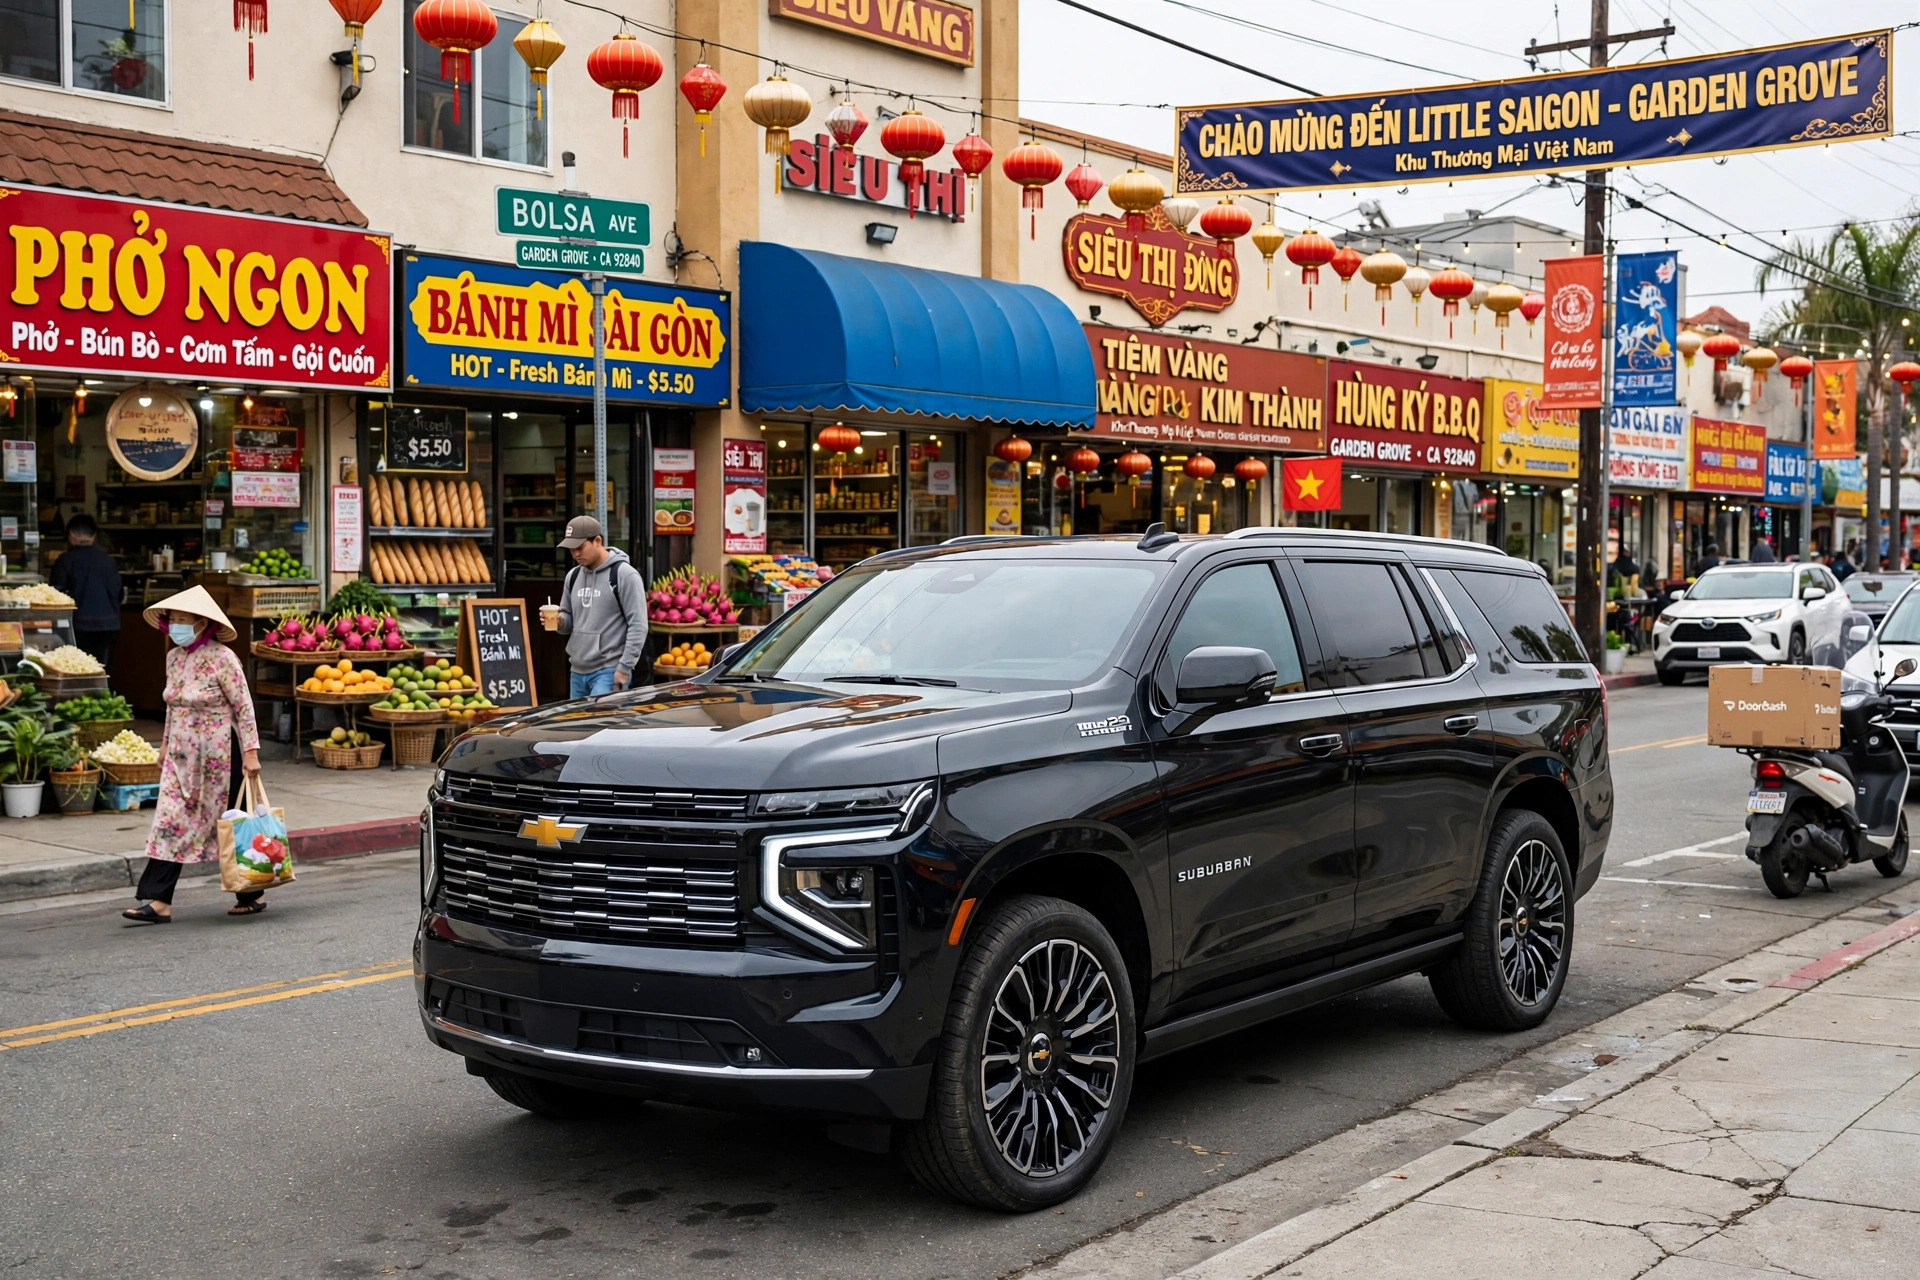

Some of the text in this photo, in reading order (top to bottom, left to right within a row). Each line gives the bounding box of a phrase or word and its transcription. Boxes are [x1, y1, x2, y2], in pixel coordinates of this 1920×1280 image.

[1200, 114, 1264, 158] CHÀO
[1270, 109, 1343, 154] MỪNG
[1350, 98, 1401, 148] ĐẾN
[1408, 100, 1491, 143] LITTLE
[1498, 89, 1600, 136] SAIGON
[1628, 71, 1747, 122] GARDEN
[1756, 56, 1859, 107] GROVE
[1395, 137, 1613, 172] Khu Thương Mại Việt Nam
[513, 198, 638, 234] BOLSA AVE
[9, 209, 369, 335] PHỞ NGON
[521, 246, 558, 263] GARDEN
[561, 250, 590, 265] GROVE
[600, 252, 612, 267] CA
[614, 253, 641, 268] 92840
[1078, 227, 1133, 280] SIÊU
[1138, 243, 1177, 298] THỊ
[427, 278, 528, 342] BÁNH
[537, 291, 579, 347] MÌ
[650, 303, 713, 360] GÒN
[12, 320, 60, 352] Phở
[81, 327, 125, 357] Bún
[131, 331, 160, 360] Bò
[180, 335, 227, 364] Cơm
[232, 336, 275, 367] Tấm
[292, 343, 324, 376] Gỏi
[328, 346, 375, 375] Cuốn
[1102, 334, 1228, 382] TIỆM VÀNG
[451, 353, 492, 379] HOT
[510, 359, 558, 383] Fresh
[612, 367, 632, 389] Mì
[648, 369, 694, 394] $5.50
[1201, 387, 1243, 425] KIM
[1249, 386, 1322, 431] THÀNH
[1336, 371, 1396, 430] HÙNG
[1401, 380, 1430, 432] KÝ
[1432, 393, 1481, 443] B.B.Q
[408, 436, 452, 461] $5.50
[1330, 438, 1375, 459] GARDEN
[1377, 441, 1412, 462] GROVE
[1426, 446, 1441, 464] CA
[1444, 450, 1476, 467] 92840
[478, 627, 509, 643] Fresh
[479, 609, 509, 626] HOT
[488, 679, 526, 700] $5.50
[1177, 856, 1252, 882] SUBURBAN
